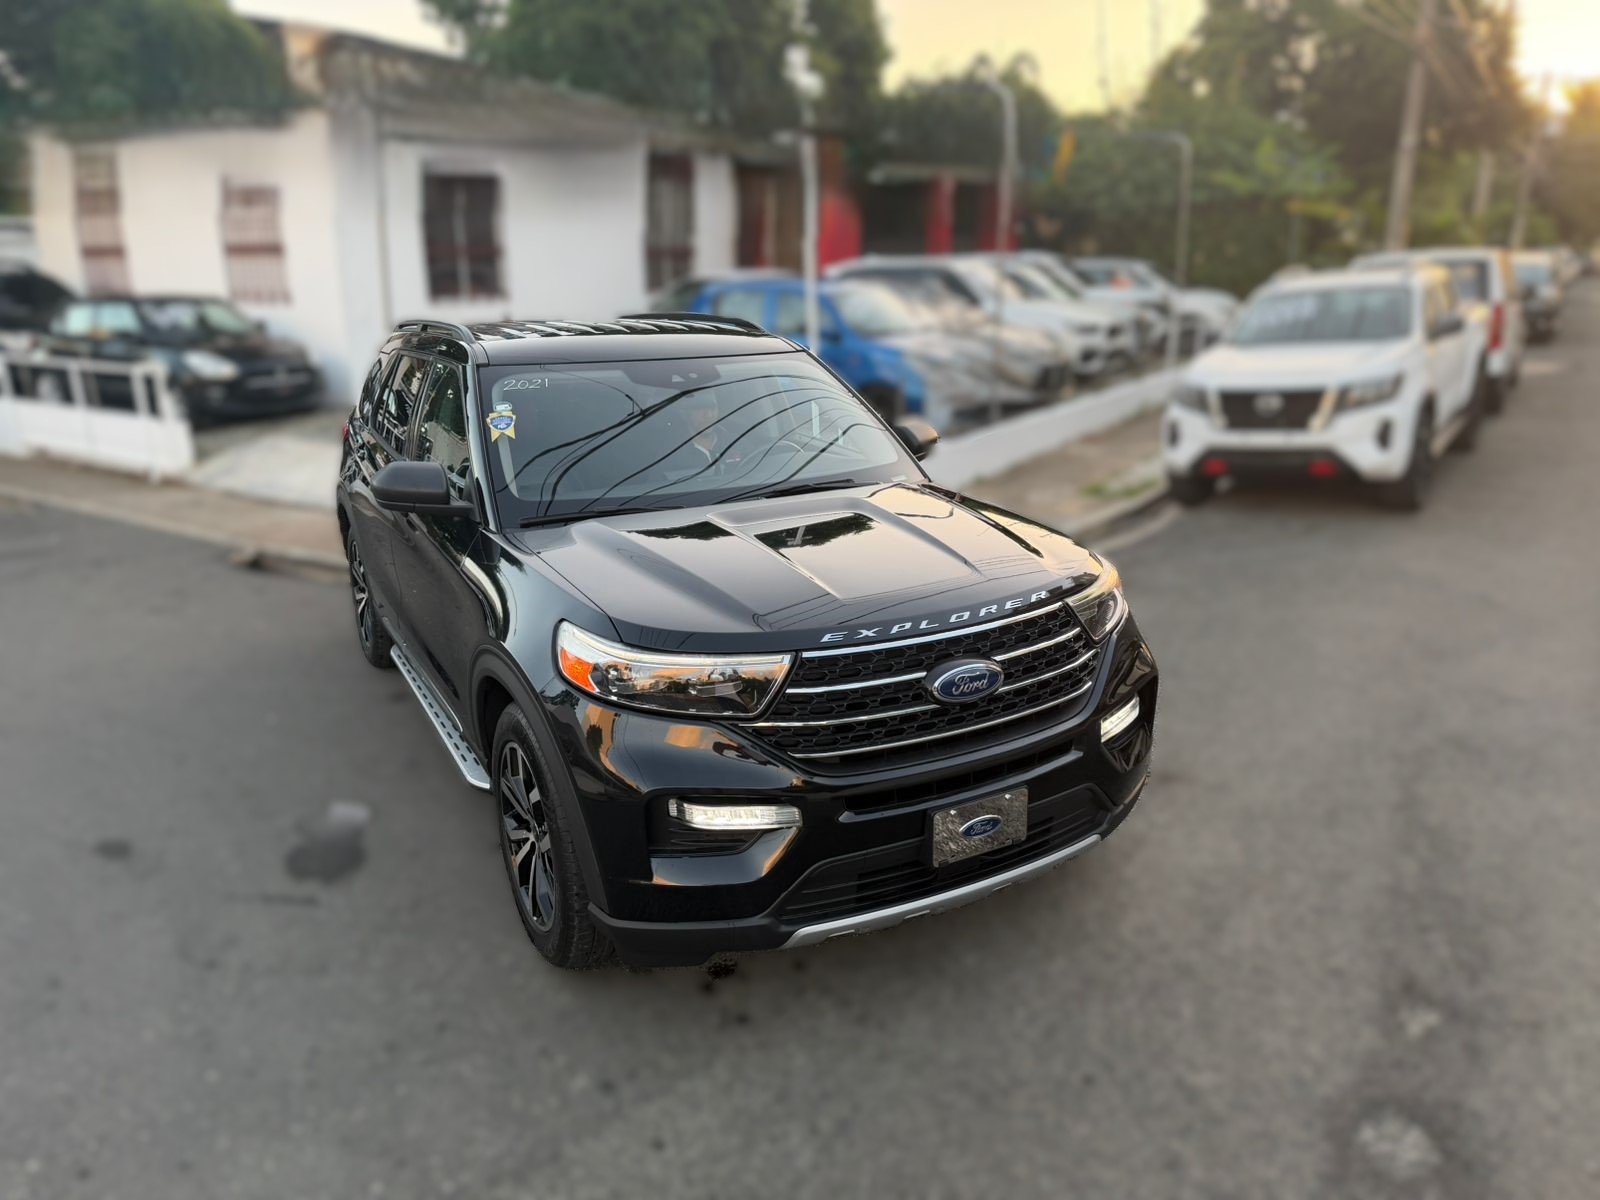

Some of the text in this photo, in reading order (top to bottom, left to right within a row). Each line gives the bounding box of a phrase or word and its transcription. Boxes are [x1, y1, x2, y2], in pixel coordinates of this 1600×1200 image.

[503, 378, 549, 391] 2021
[820, 590, 1050, 643] EXPLORER
[952, 672, 988, 696] Ford
[970, 821, 993, 835] Ford
